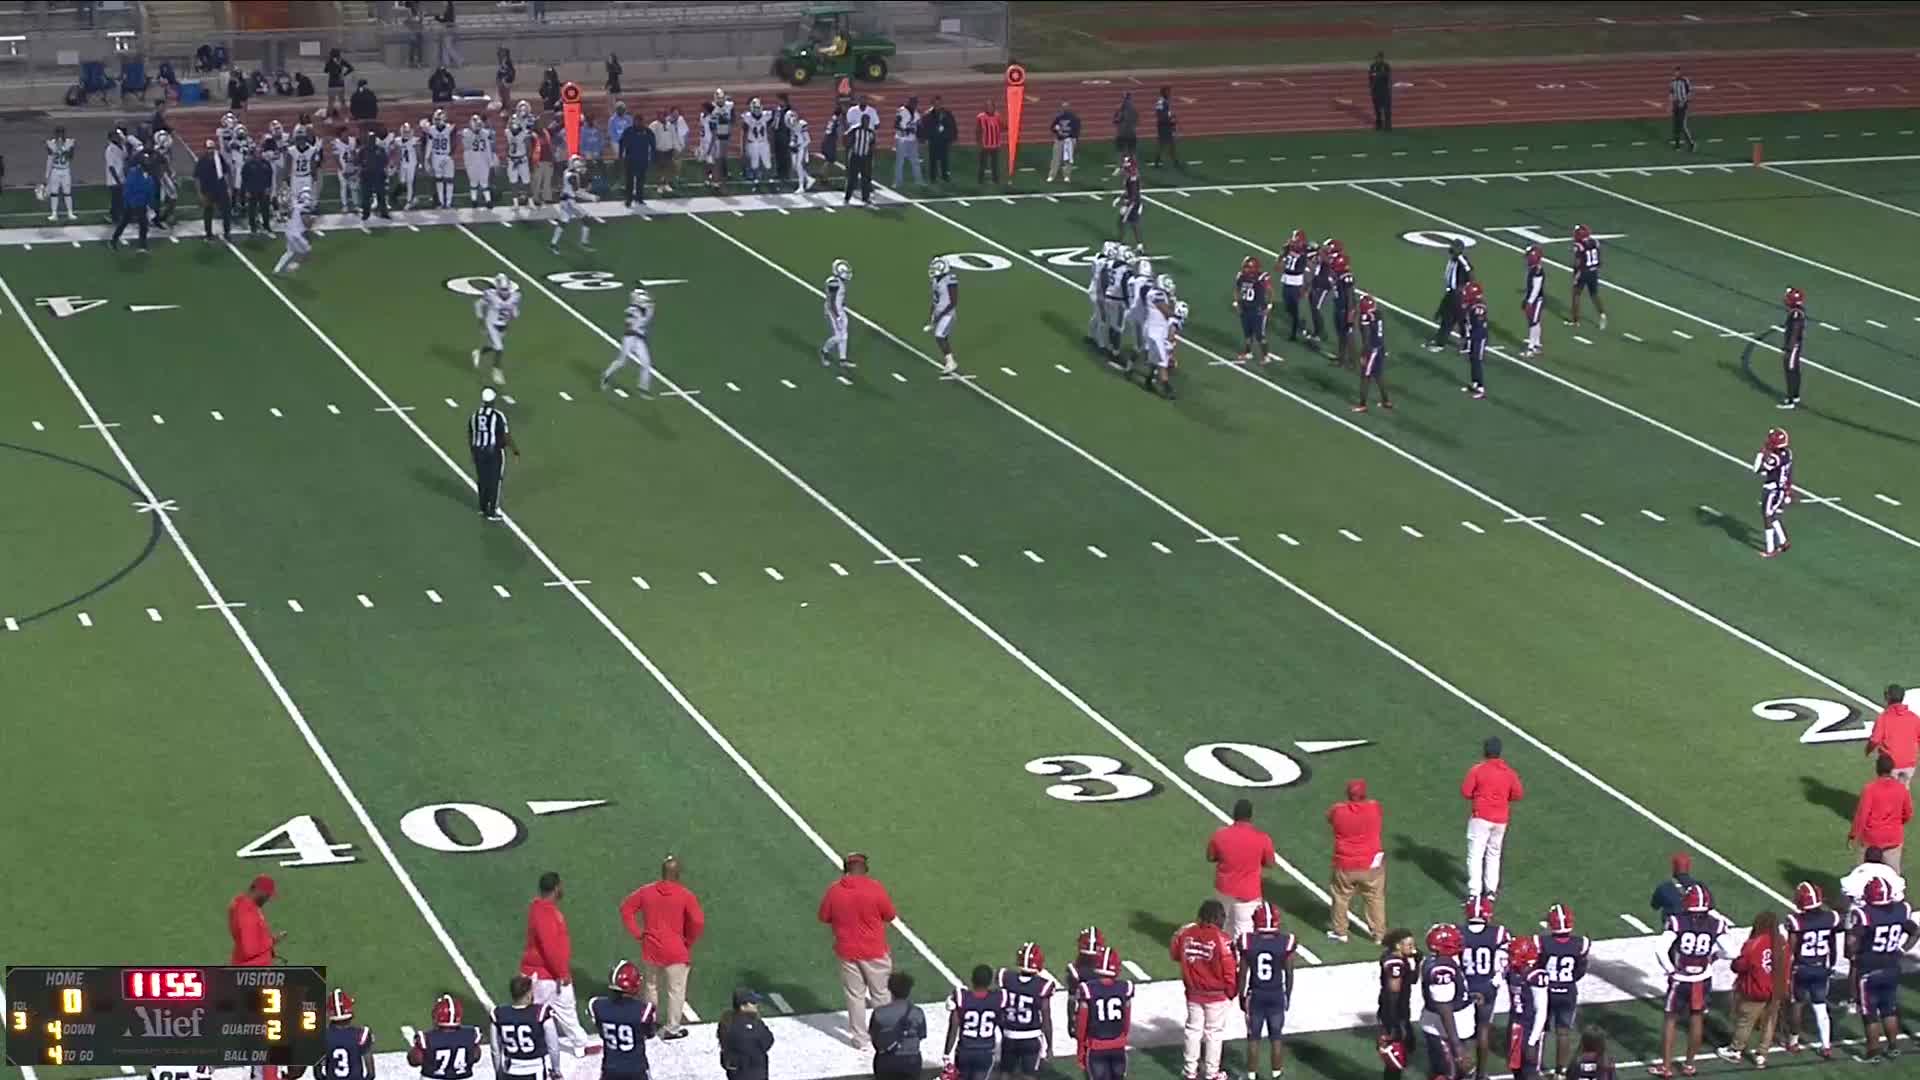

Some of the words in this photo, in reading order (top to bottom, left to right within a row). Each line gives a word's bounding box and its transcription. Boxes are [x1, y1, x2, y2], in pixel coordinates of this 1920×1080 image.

[838, 78, 848, 96] 4
[296, 160, 308, 172] 12
[1801, 930, 1830, 956] 25
[1872, 925, 1902, 952] 58
[1257, 953, 1272, 980] 6
[1392, 966, 1400, 976] 5
[1463, 948, 1491, 975] 40
[1096, 998, 1123, 1021] 16
[603, 1024, 634, 1051] 59
[963, 1011, 996, 1038] 26
[500, 1025, 534, 1053] 56
[332, 1049, 349, 1077] 3
[435, 1049, 467, 1073] 74
